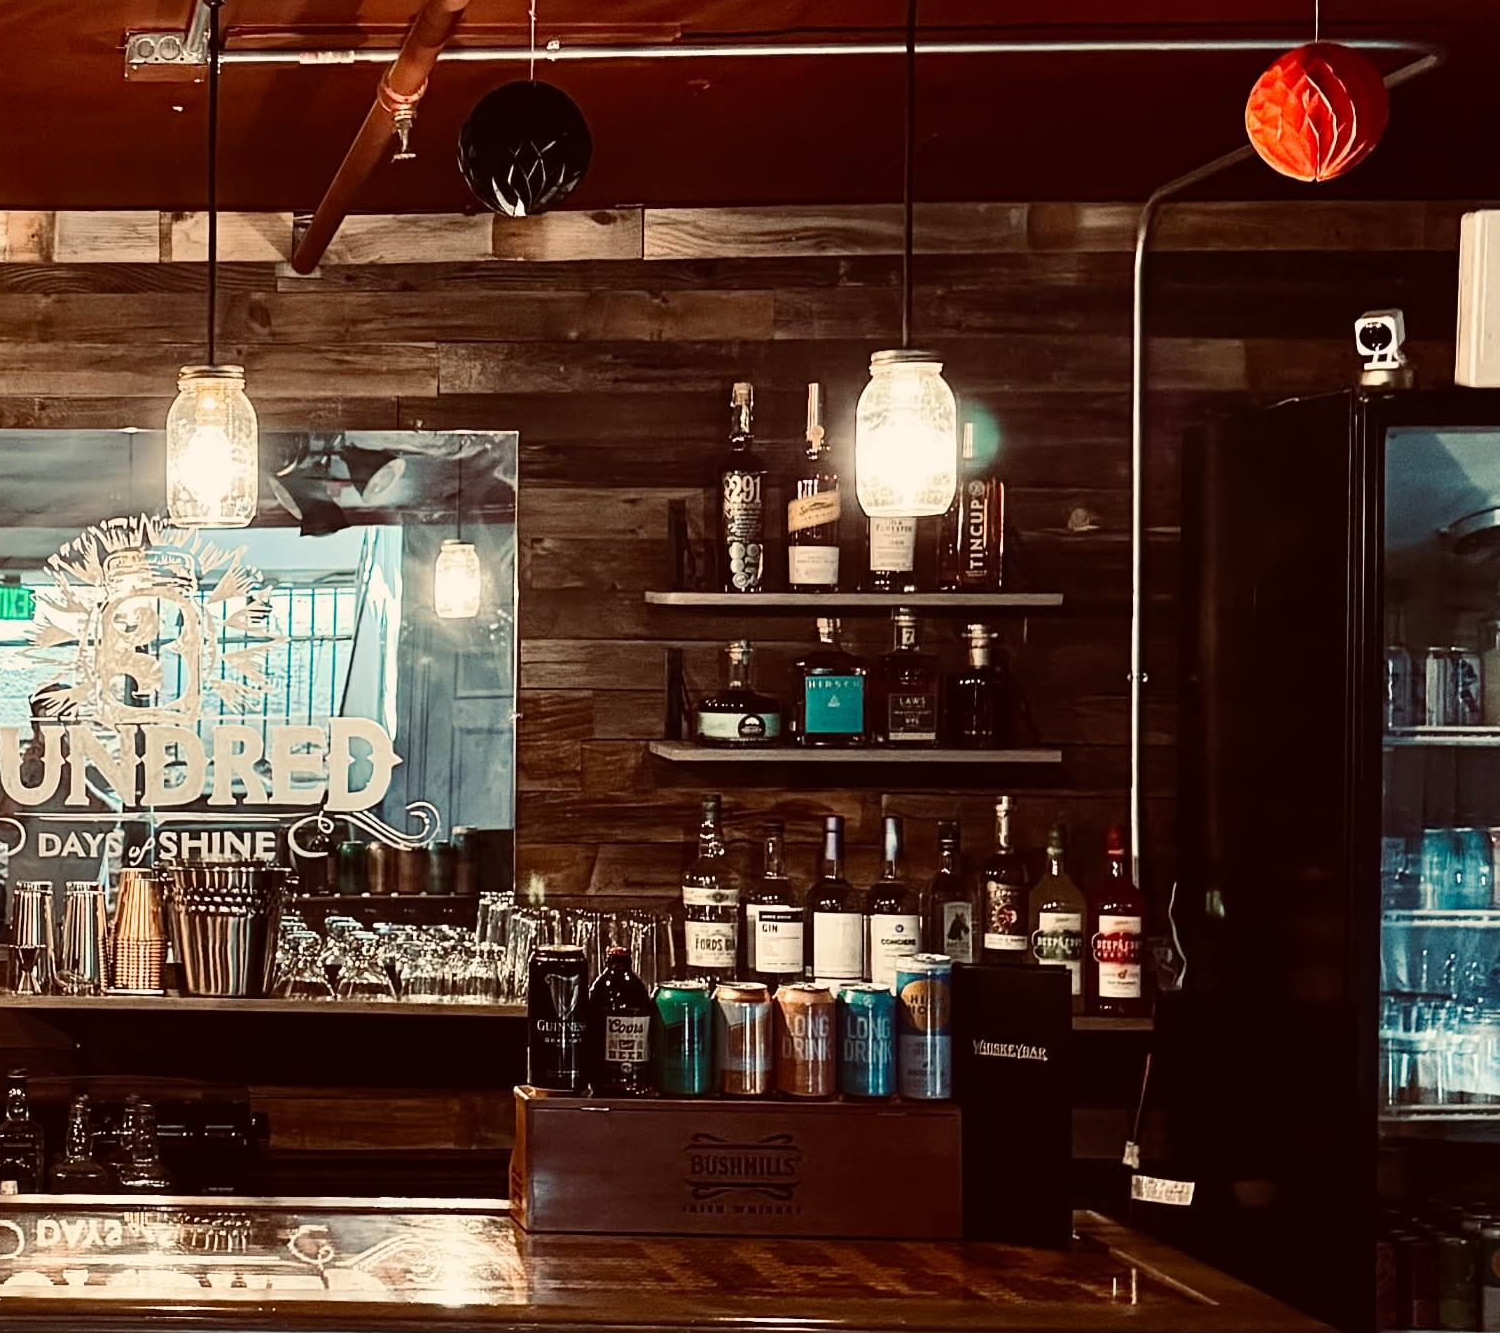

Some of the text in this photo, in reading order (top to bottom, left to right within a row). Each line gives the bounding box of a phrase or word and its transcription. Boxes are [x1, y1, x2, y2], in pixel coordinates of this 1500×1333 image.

[729, 474, 762, 503] 291
[969, 499, 984, 570] TINCUP
[807, 679, 862, 689] HIRSCH
[899, 697, 926, 707] LAWS
[37, 830, 277, 866] DAYS of SHINE
[762, 923, 778, 932] GIN
[695, 937, 722, 951] FORDS
[846, 1017, 891, 1039] LONG
[691, 1154, 796, 1177] BUSHMILLS
